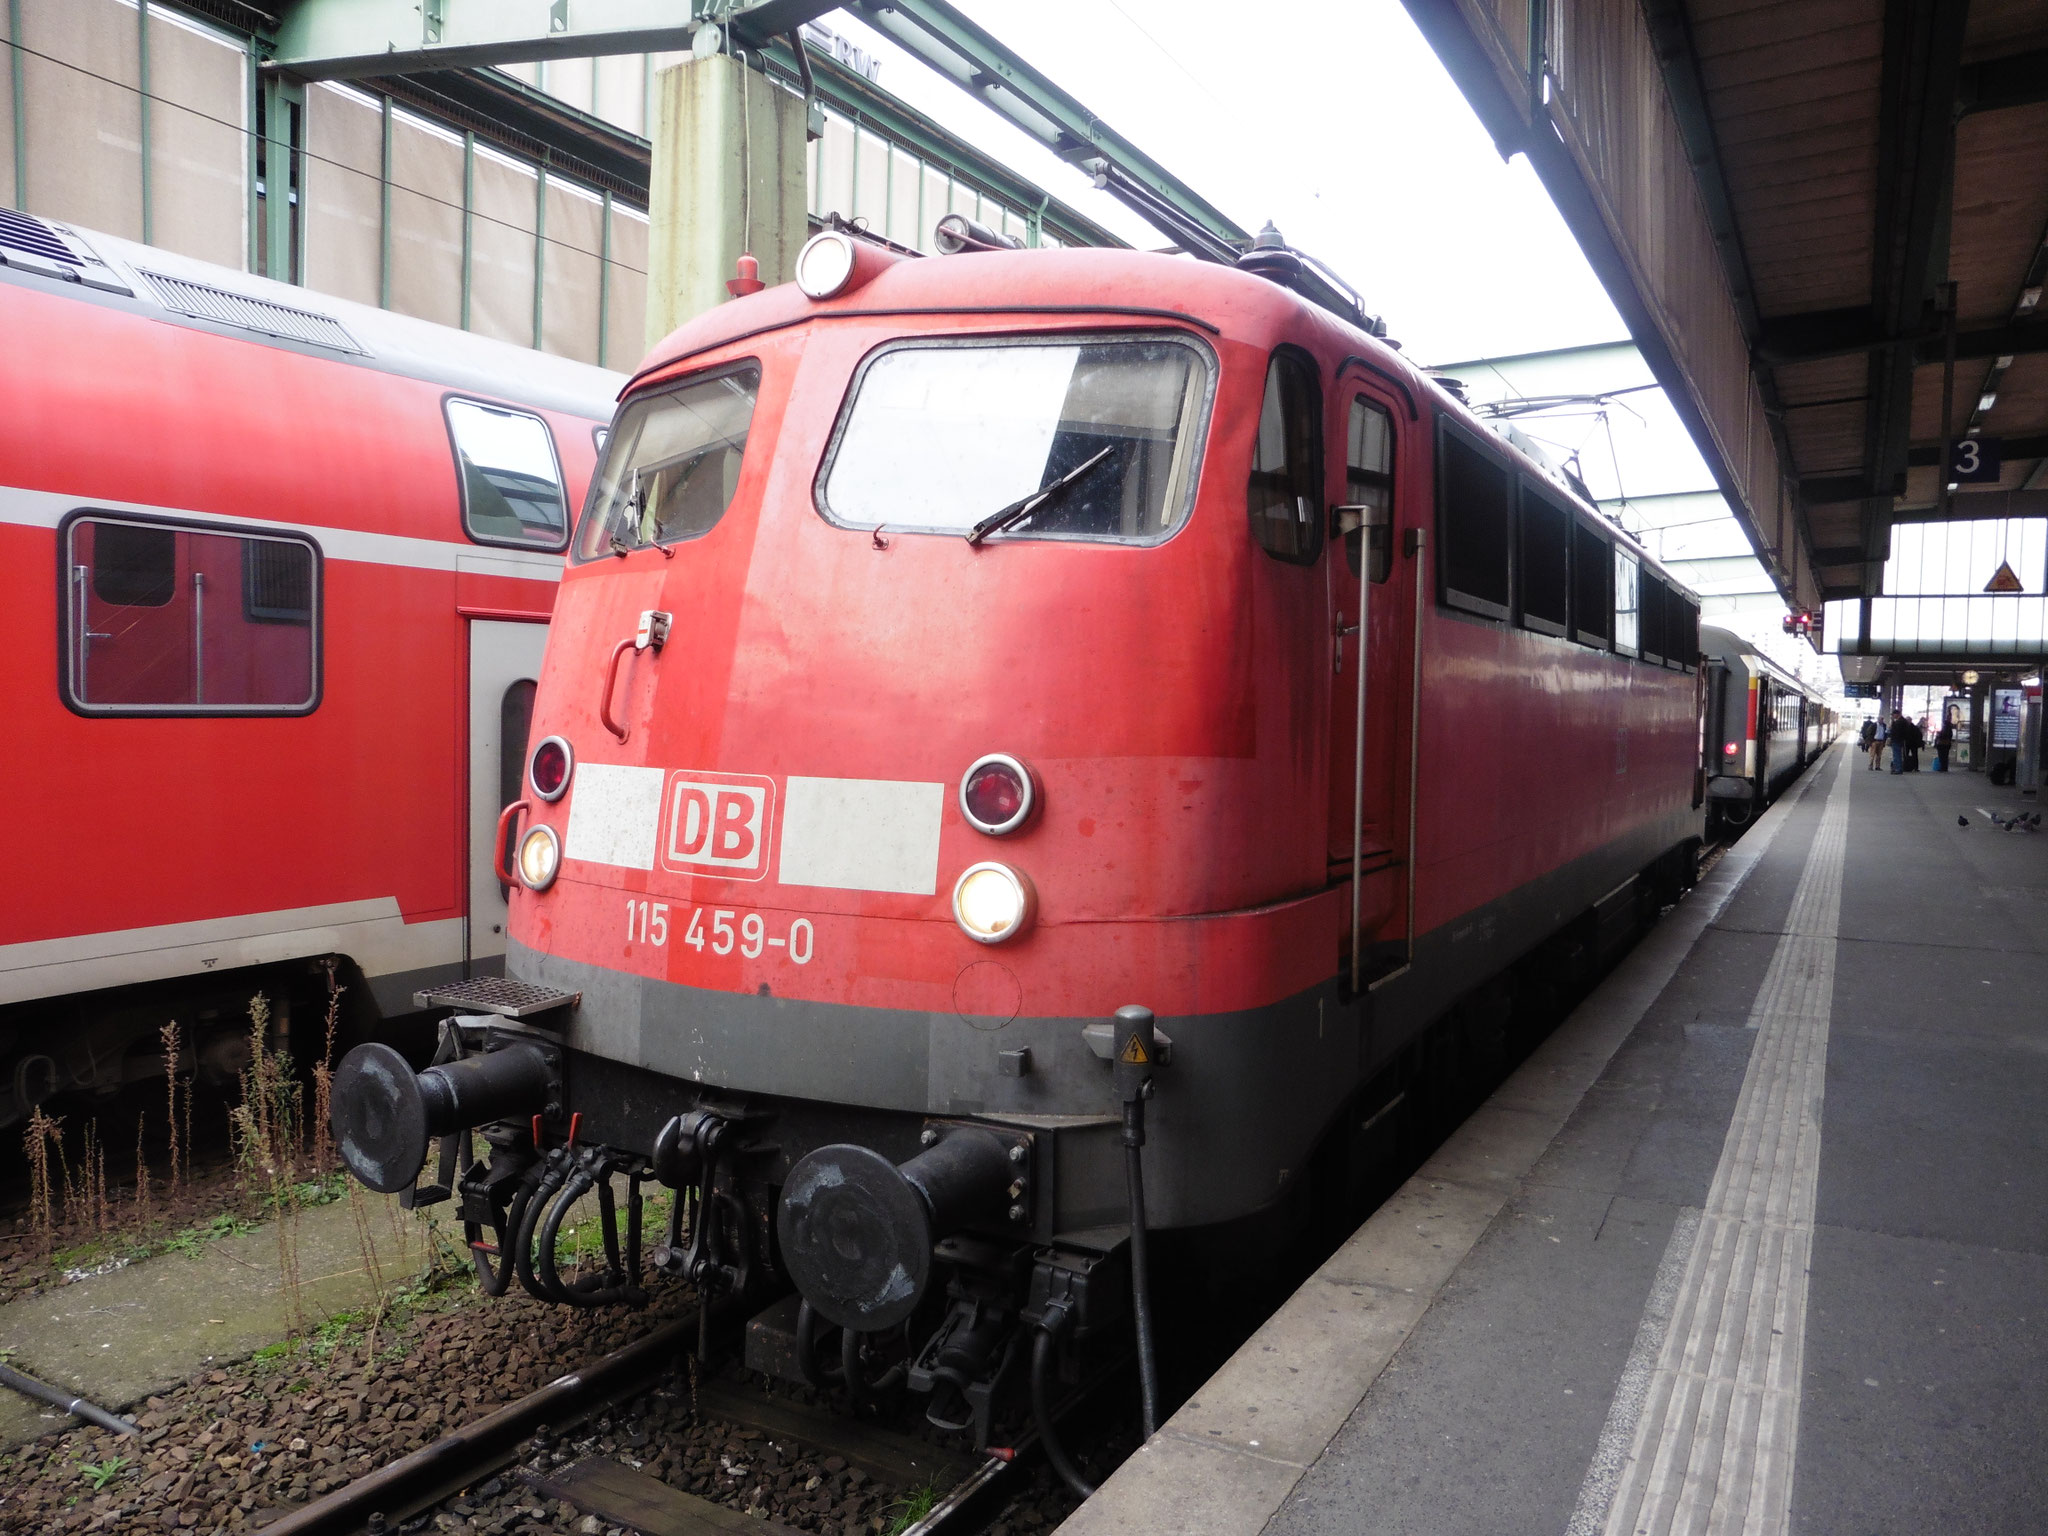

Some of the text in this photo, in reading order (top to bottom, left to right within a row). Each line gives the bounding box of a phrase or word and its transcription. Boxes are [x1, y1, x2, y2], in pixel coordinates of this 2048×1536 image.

[1955, 440, 1980, 474] 3
[674, 787, 756, 860] DB
[626, 899, 814, 965] 115 459-0
